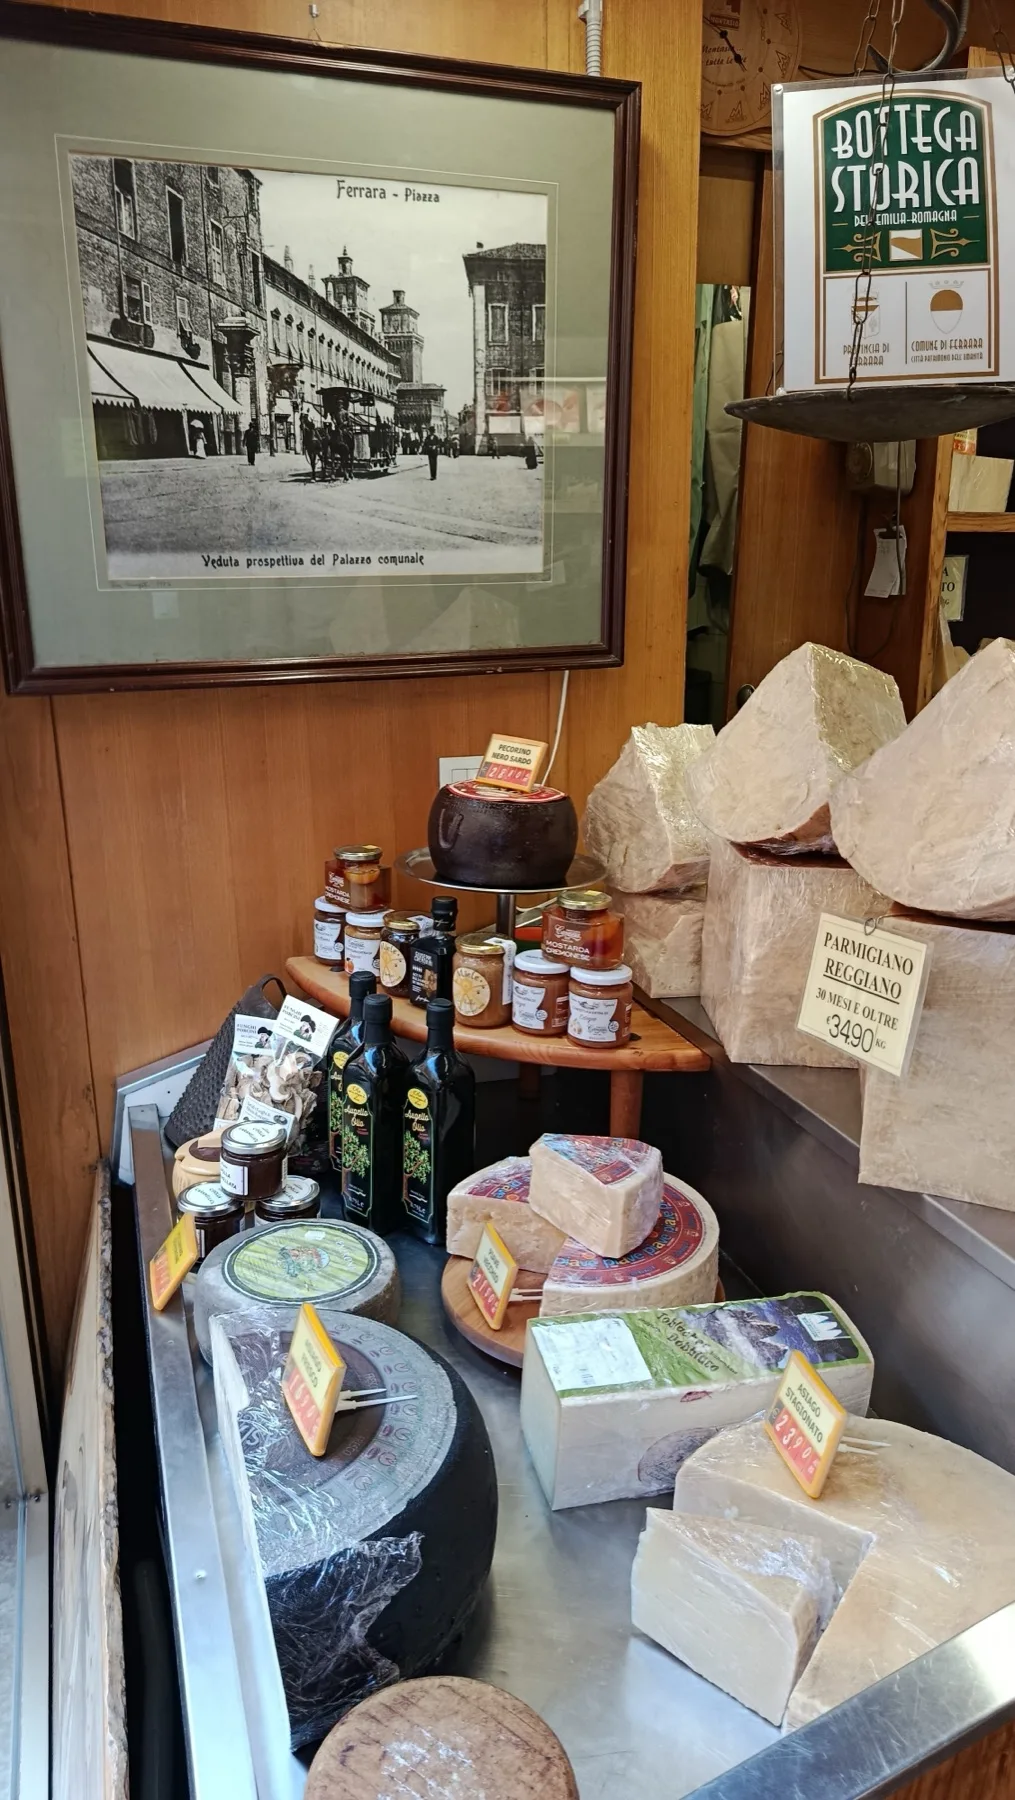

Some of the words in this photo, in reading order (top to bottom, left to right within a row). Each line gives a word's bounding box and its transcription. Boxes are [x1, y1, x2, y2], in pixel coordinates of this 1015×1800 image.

[831, 104, 977, 159] BOTTEGA
[337, 180, 387, 200] Ferrara
[405, 187, 440, 202] Piazza
[831, 157, 980, 213] STORICA
[882, 343, 890, 353] DI
[911, 340, 938, 352] COMUNE
[940, 340, 947, 350] DI
[949, 338, 983, 350] FERRARA
[201, 555, 239, 569] Veduta
[246, 554, 304, 568] prospettiva
[310, 554, 325, 566] del
[332, 553, 371, 566] Palazzo
[378, 552, 424, 566] comunale
[491, 752, 509, 761] NERO
[509, 755, 532, 765] SARDO
[498, 744, 532, 756] PECORINO
[546, 940, 590, 954] MOSTARDA
[824, 932, 914, 976] PARMIGIANO
[825, 958, 902, 1000] REGGIANO
[816, 988, 826, 1000] 30
[828, 992, 851, 1012] MESI
[854, 1002, 861, 1014] E
[862, 1006, 898, 1031] OLTRE
[875, 1038, 887, 1049] KG
[644, 1233, 672, 1257] piave
[553, 1256, 599, 1268] piave
[602, 1252, 645, 1268] piave
[797, 1384, 821, 1418] ASIAGO
[785, 1387, 823, 1443] STAGIONATO
